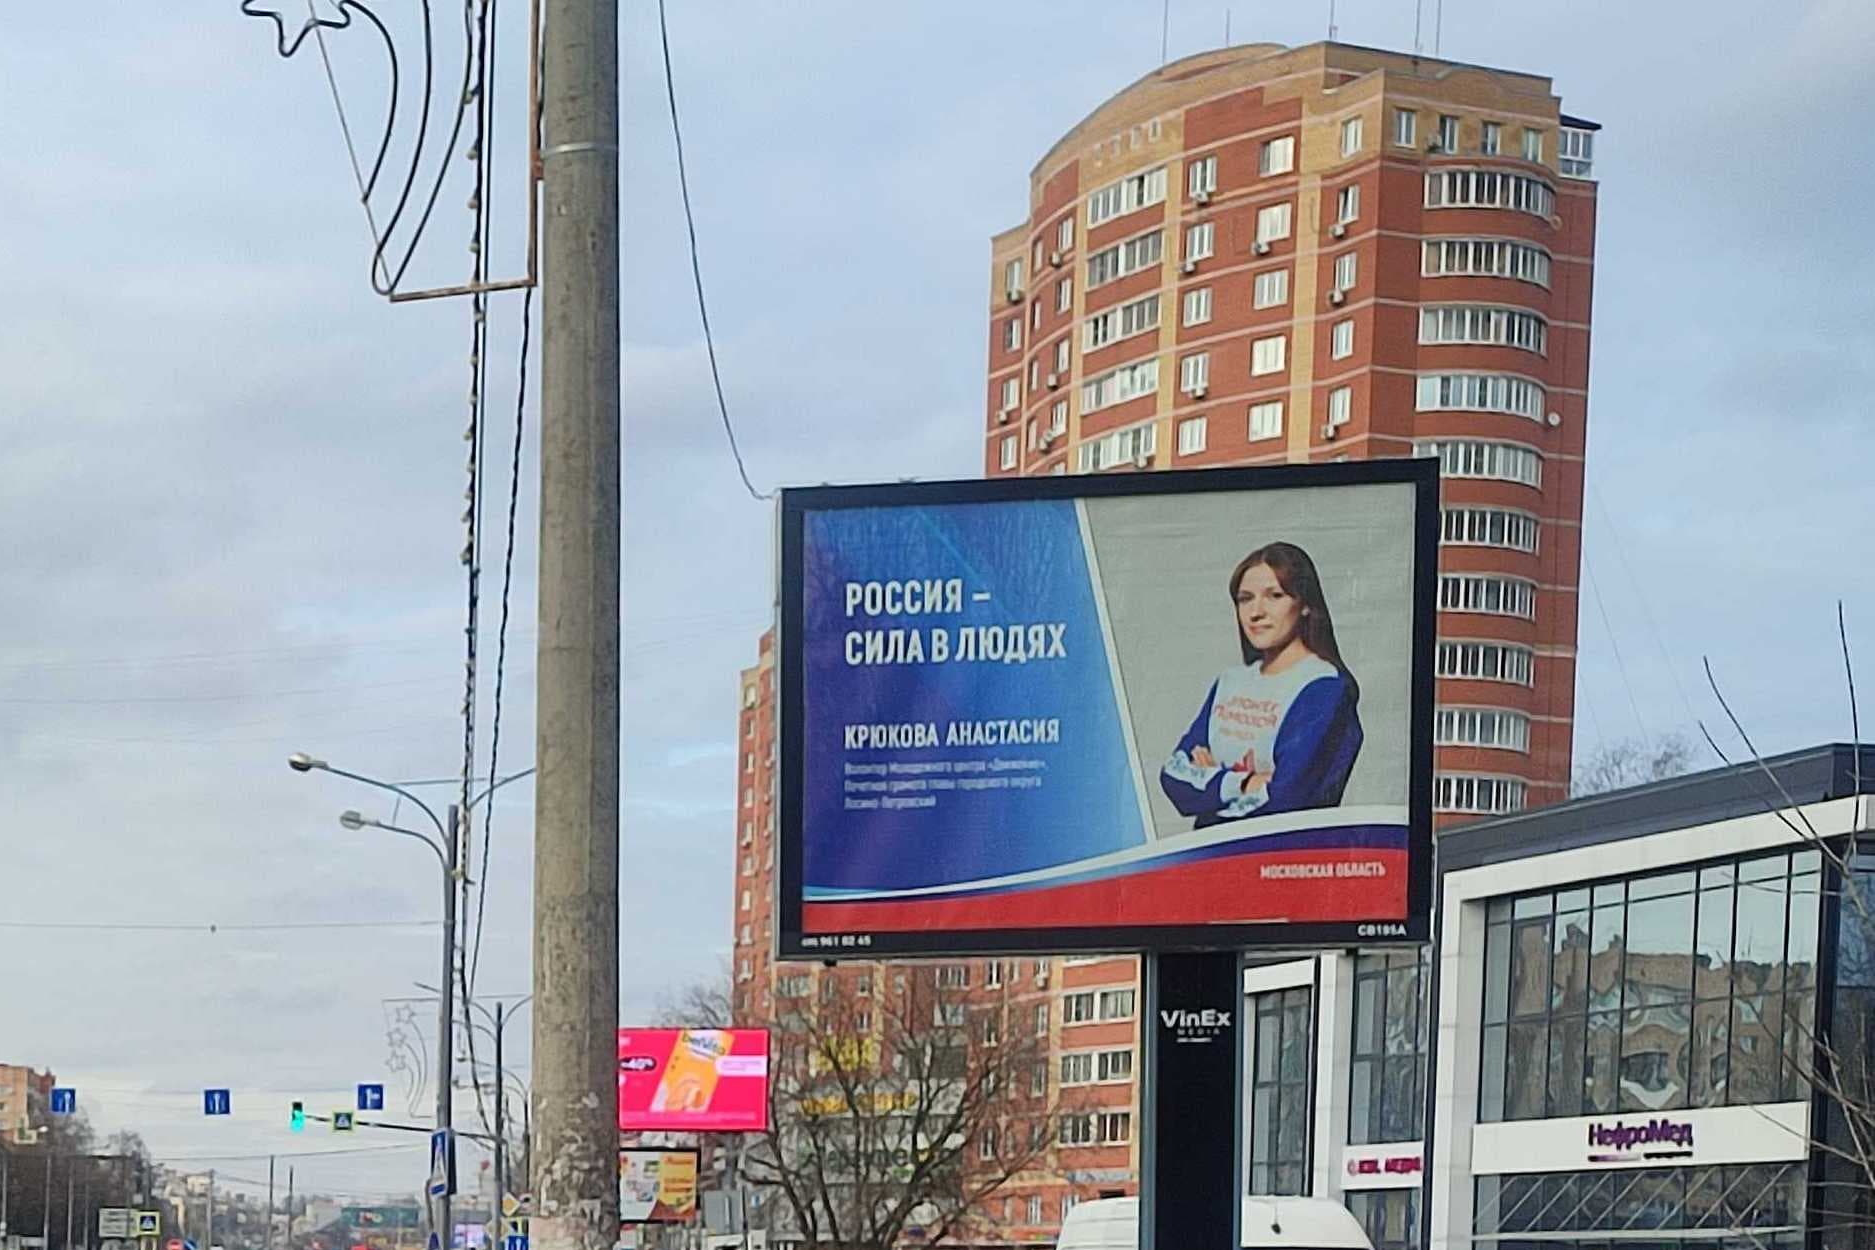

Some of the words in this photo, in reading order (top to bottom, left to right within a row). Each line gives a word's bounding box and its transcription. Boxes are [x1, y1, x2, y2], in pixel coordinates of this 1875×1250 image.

[845, 578, 963, 617] РОССИЯ
[845, 629, 925, 666] СИЛА
[930, 628, 950, 663] В
[954, 622, 1068, 665] ЛЮДЯХ
[844, 723, 940, 750] КРЮКОВА
[945, 718, 1061, 747] АНАСТАСИЯ
[1336, 861, 1386, 878] ОБЛАСТЬ
[1160, 1008, 1231, 1028] VinEx
[1588, 1118, 1694, 1151] НефроМед
